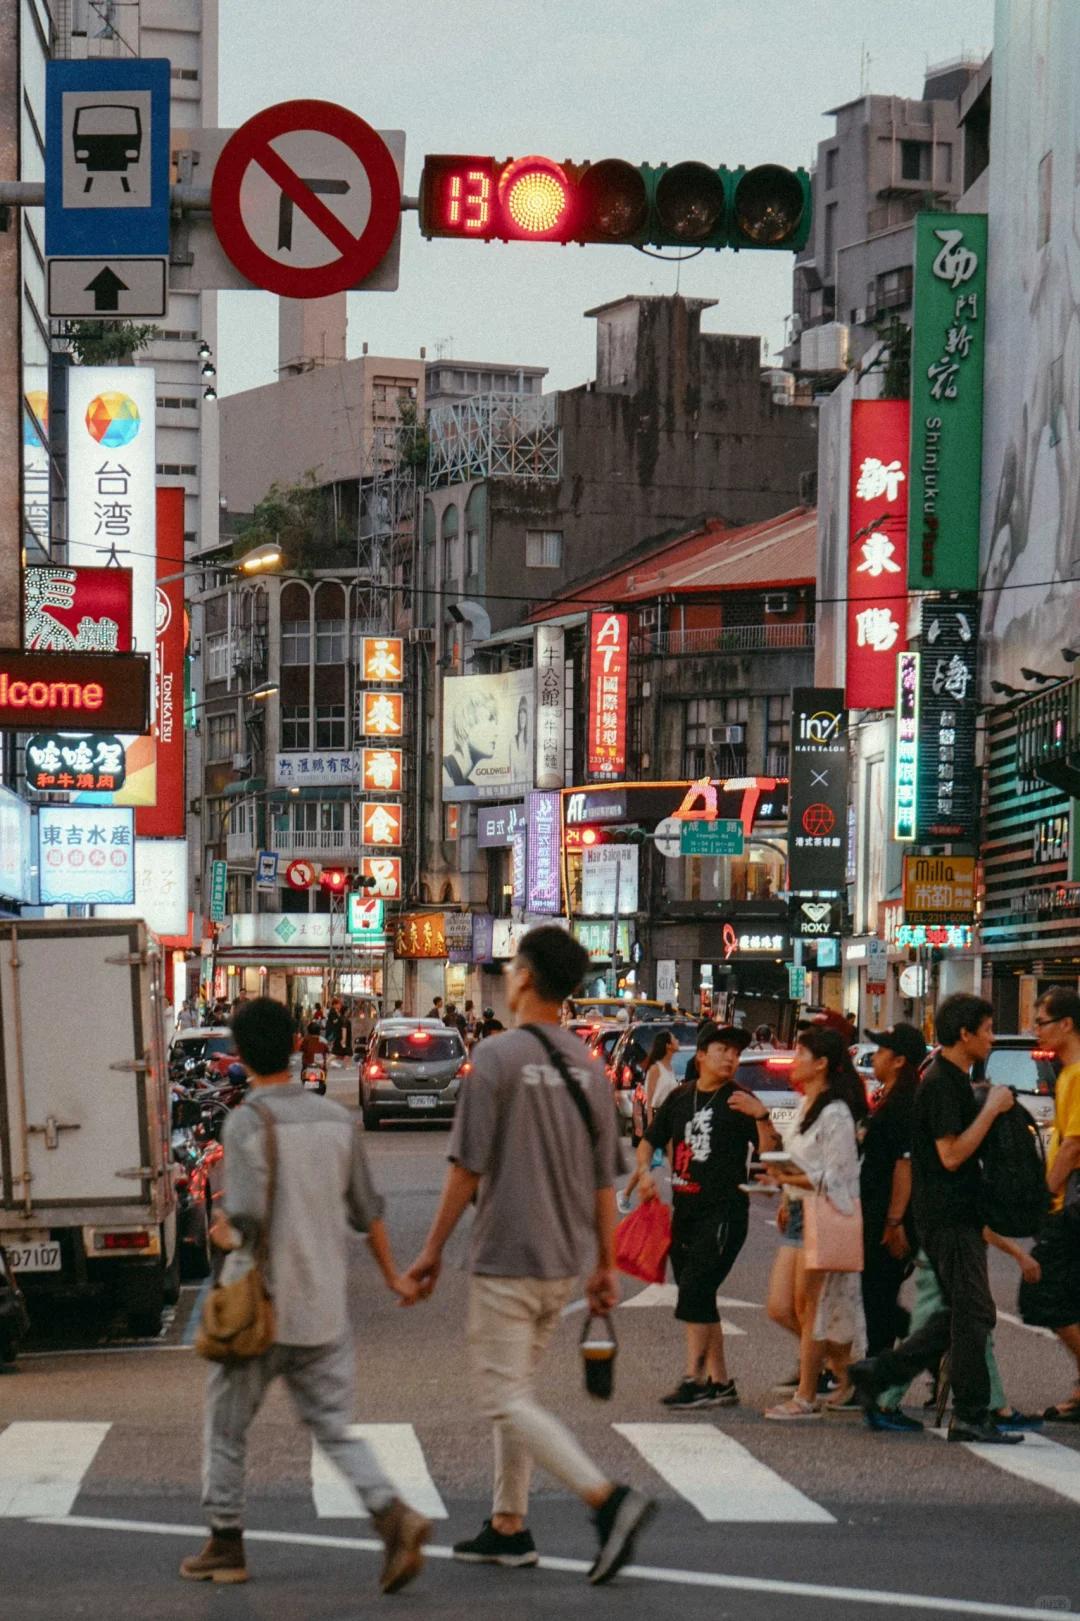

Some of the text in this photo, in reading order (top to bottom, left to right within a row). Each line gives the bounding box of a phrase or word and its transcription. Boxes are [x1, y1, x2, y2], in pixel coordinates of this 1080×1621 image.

[450, 170, 490, 229] 13
[924, 415, 942, 514] Shinjuku
[855, 457, 906, 652] 新東陽
[162, 671, 174, 743] TONKATSU
[566, 829, 581, 844] 24
[915, 859, 955, 882] Milla
[801, 923, 831, 934] ROXY
